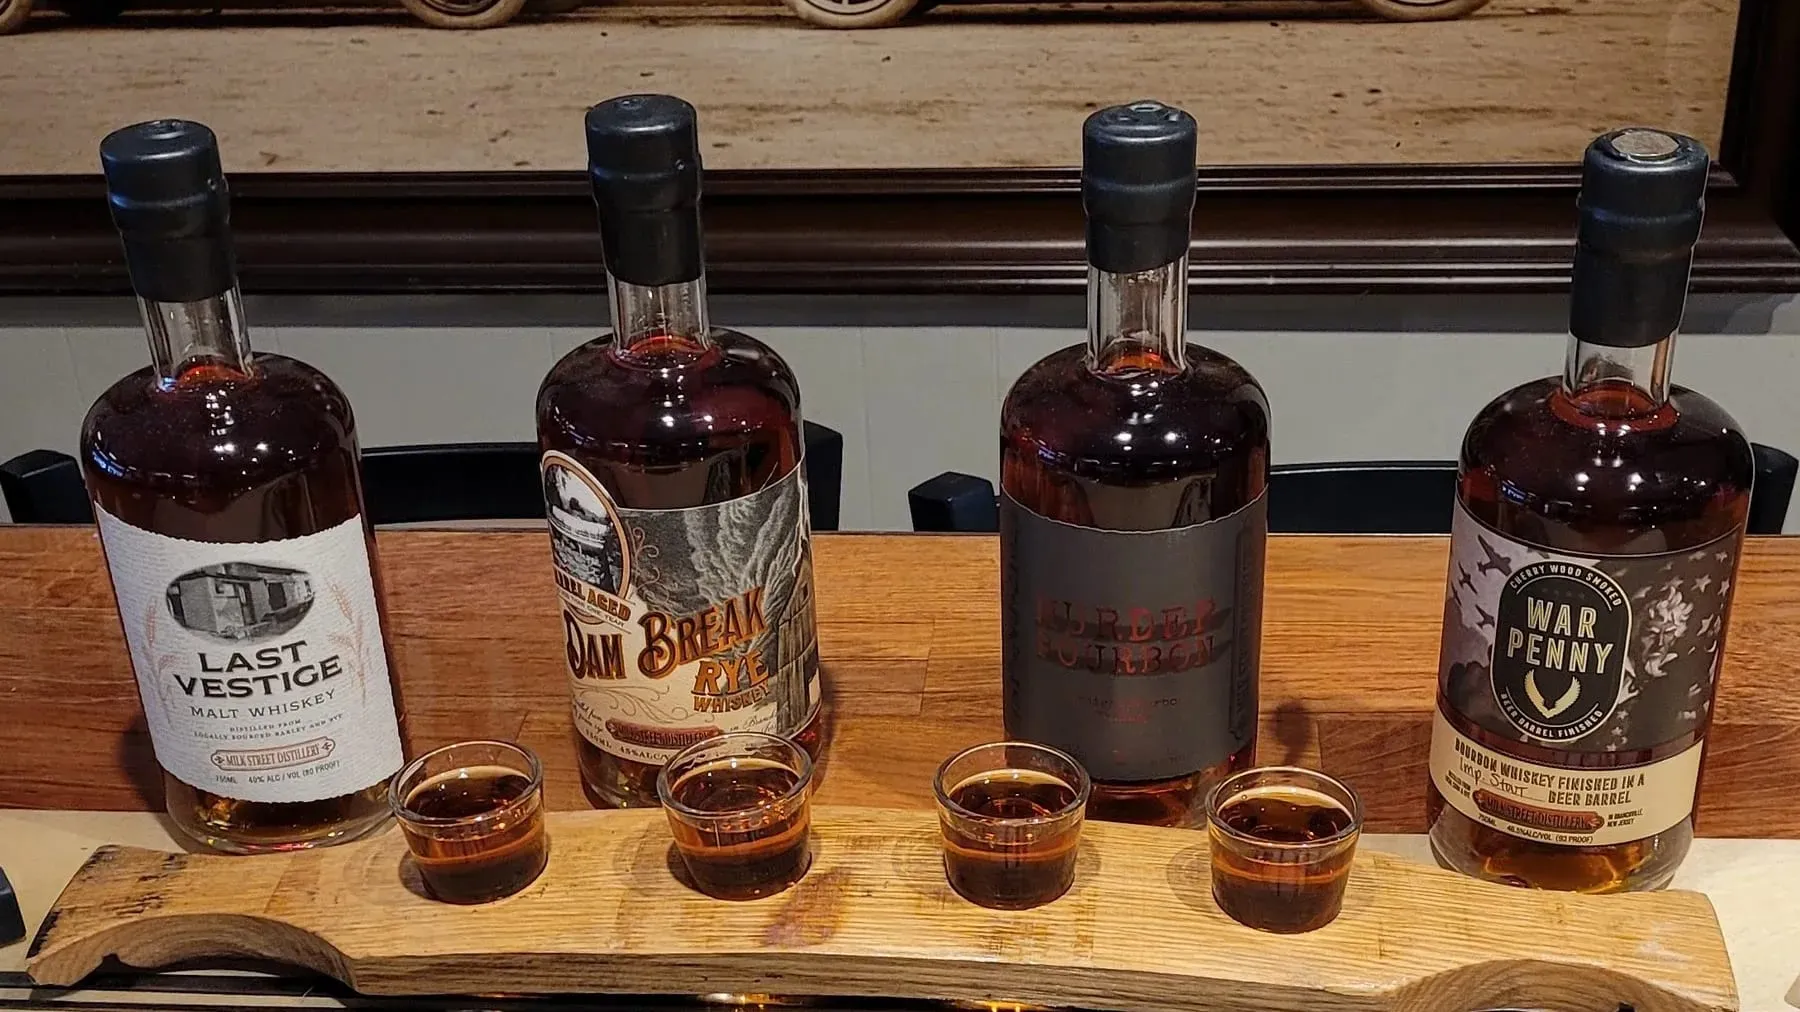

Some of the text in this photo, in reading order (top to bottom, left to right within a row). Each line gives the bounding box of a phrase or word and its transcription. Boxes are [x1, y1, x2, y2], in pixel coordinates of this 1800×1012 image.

[1509, 564, 1622, 607] CHERRY WOOD SMOKED
[587, 588, 631, 622] AGED
[1527, 596, 1597, 639] WAR
[563, 586, 768, 680] DAM BREAK
[197, 640, 308, 673] LAST
[1506, 626, 1614, 674] PENNY
[173, 654, 343, 698] VESTIGE
[692, 650, 769, 694] RYE
[190, 688, 335, 719] MALT WHISKEY
[692, 681, 769, 713] WHISKEY
[194, 731, 228, 740] LOCALLY
[231, 732, 272, 740] SOURCED
[275, 726, 306, 737] BARLEY
[309, 720, 327, 729] AND
[229, 719, 301, 733] DISTILLED FROM
[1500, 692, 1604, 738] BEER BARREL FINISHED
[225, 743, 321, 767] MILK STREET DISTILLERY
[1455, 737, 1645, 791] BOURBON WHISKEY FINISHED IN A
[215, 774, 239, 784] 750ML
[248, 774, 265, 784] 40%
[266, 774, 281, 783] ALC
[286, 770, 301, 780] VOL
[315, 760, 341, 774] PROOF)
[1548, 790, 1632, 806] BEER BARREL
[1568, 835, 1594, 844] PROOF)
